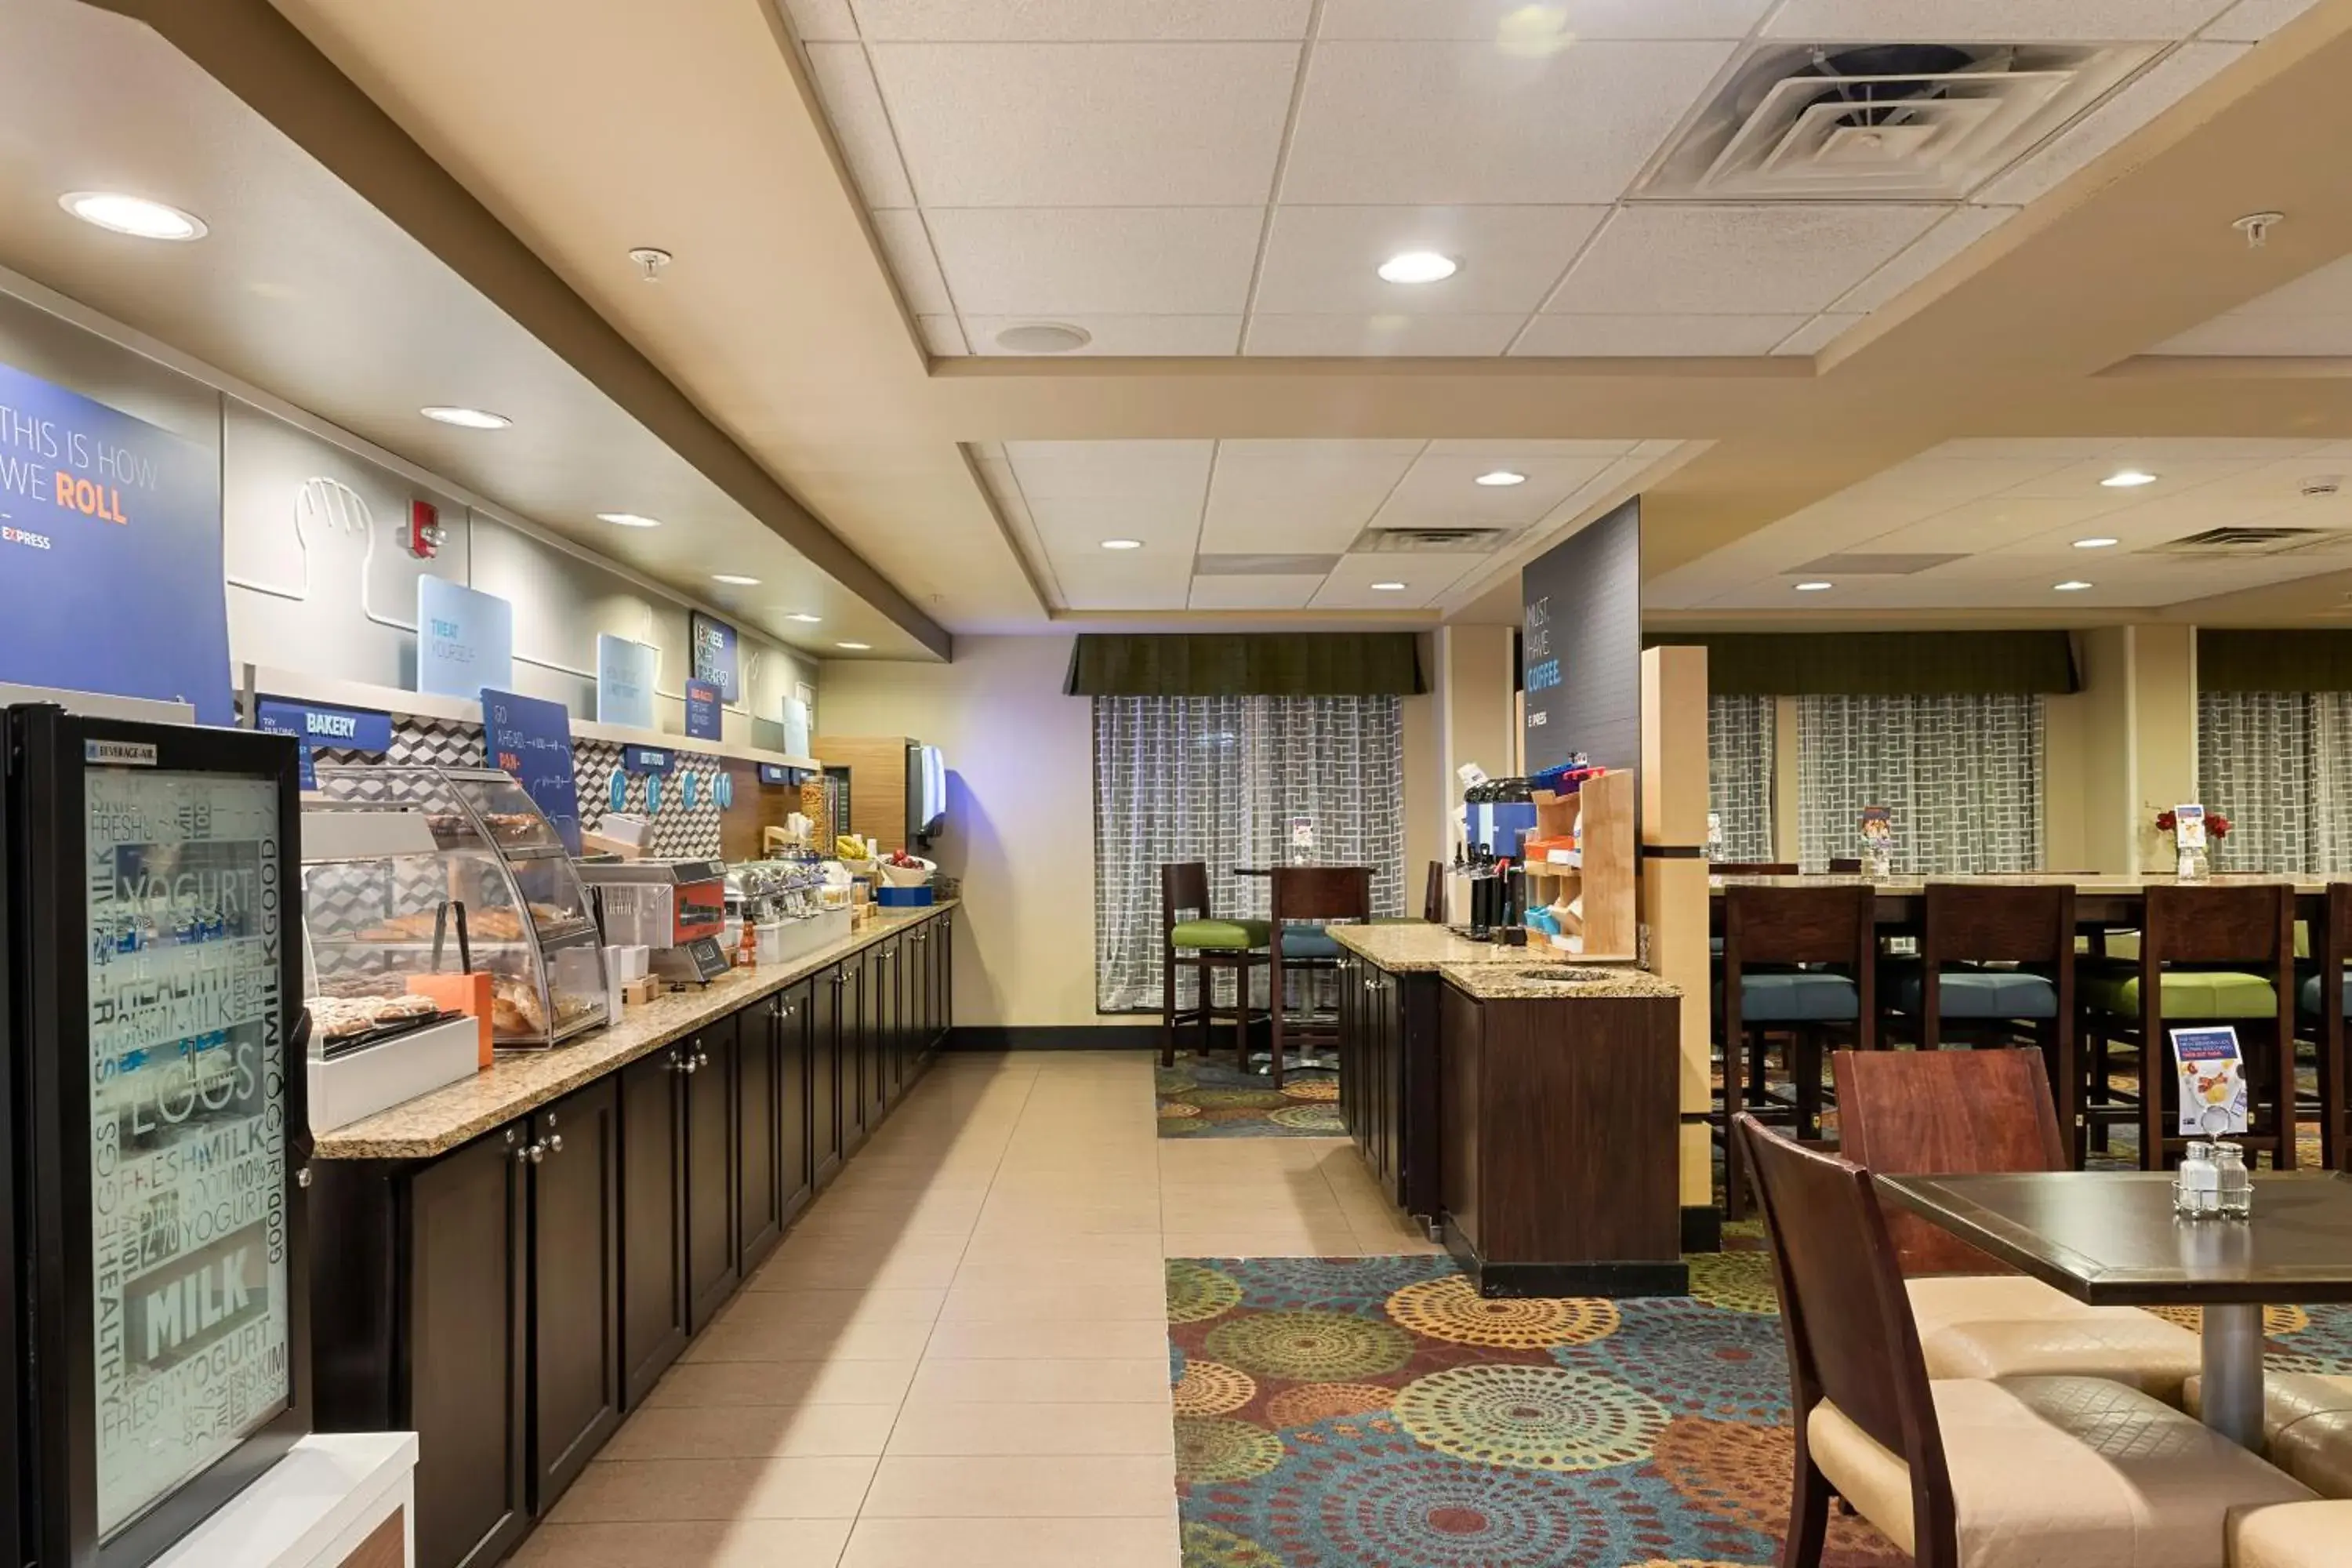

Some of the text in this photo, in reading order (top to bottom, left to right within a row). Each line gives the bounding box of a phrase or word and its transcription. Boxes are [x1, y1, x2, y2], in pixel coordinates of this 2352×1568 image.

[0, 405, 158, 491] THIS IS HOW
[0, 452, 127, 524] WE ROLL
[2, 526, 51, 550] EXPRESS
[306, 713, 356, 739] BAKERY
[123, 868, 254, 920] YOGURT
[261, 839, 279, 1048] MILK GOOD
[199, 1119, 266, 1171] MILK
[264, 1048, 284, 1189] YOGURT
[96, 1121, 117, 1240] EGGS
[182, 1185, 265, 1247] YOGURT
[267, 1192, 283, 1265] GOOD
[99, 1243, 121, 1407] HEALTHY
[147, 1245, 249, 1363] MILK
[103, 1371, 175, 1449] FRESH
[176, 1315, 271, 1399] YOGURT
[247, 1341, 285, 1392] SKIM
